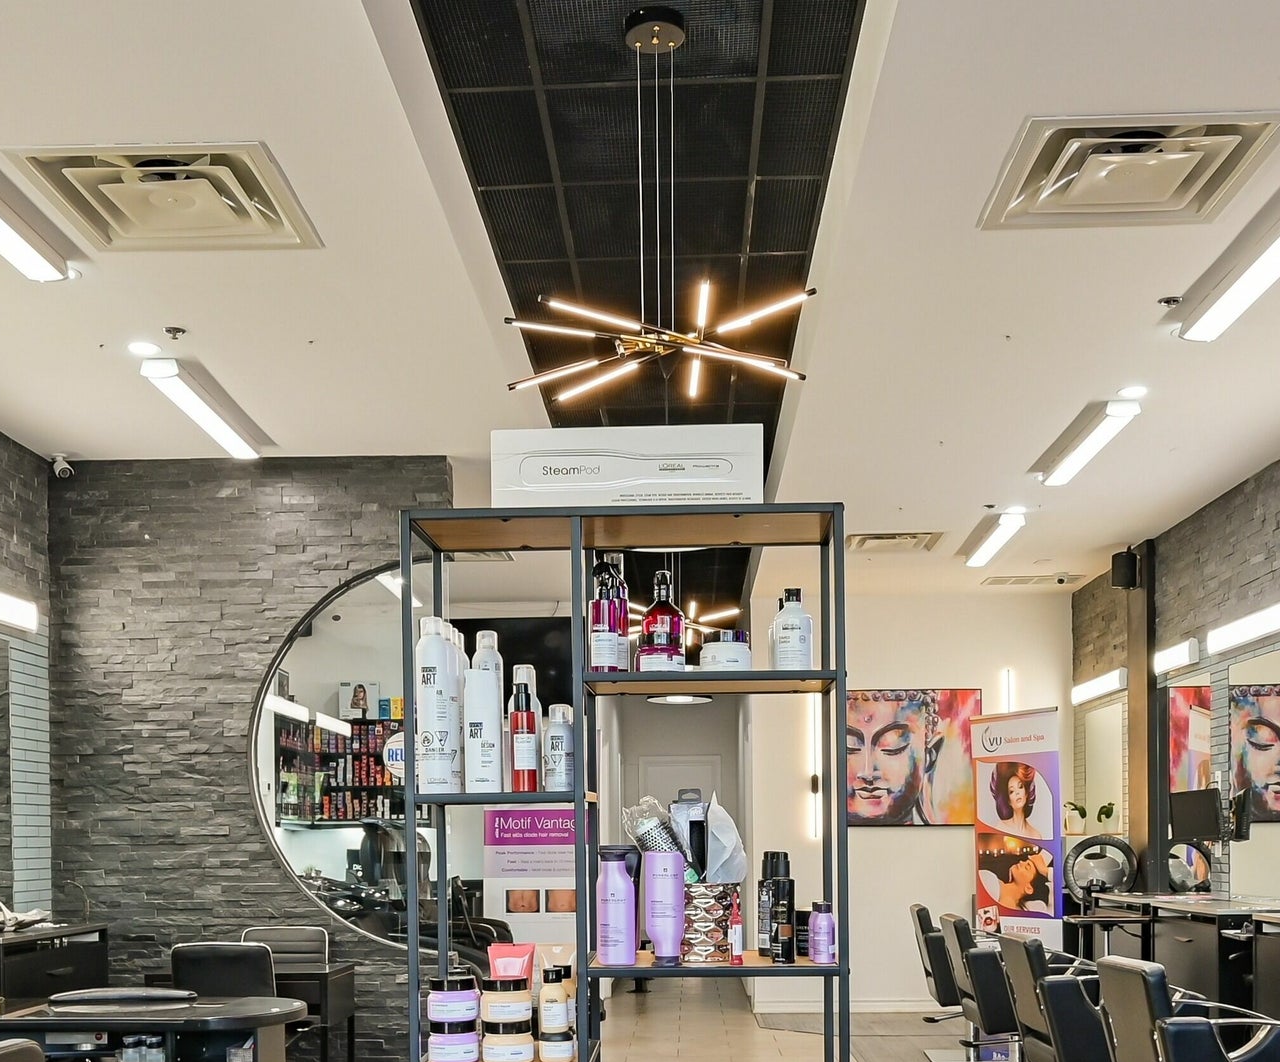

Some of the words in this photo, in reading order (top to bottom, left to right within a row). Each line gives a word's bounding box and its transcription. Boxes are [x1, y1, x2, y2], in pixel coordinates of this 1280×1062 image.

[542, 464, 601, 476] SteamPod
[421, 673, 437, 685] ART
[469, 728, 483, 739] ART
[989, 736, 1002, 746] VU
[1004, 736, 1020, 744] Salon
[1021, 734, 1032, 742] and
[1033, 734, 1045, 742] Spa
[500, 817, 532, 829] Motif
[1016, 926, 1041, 934] SERVICES
